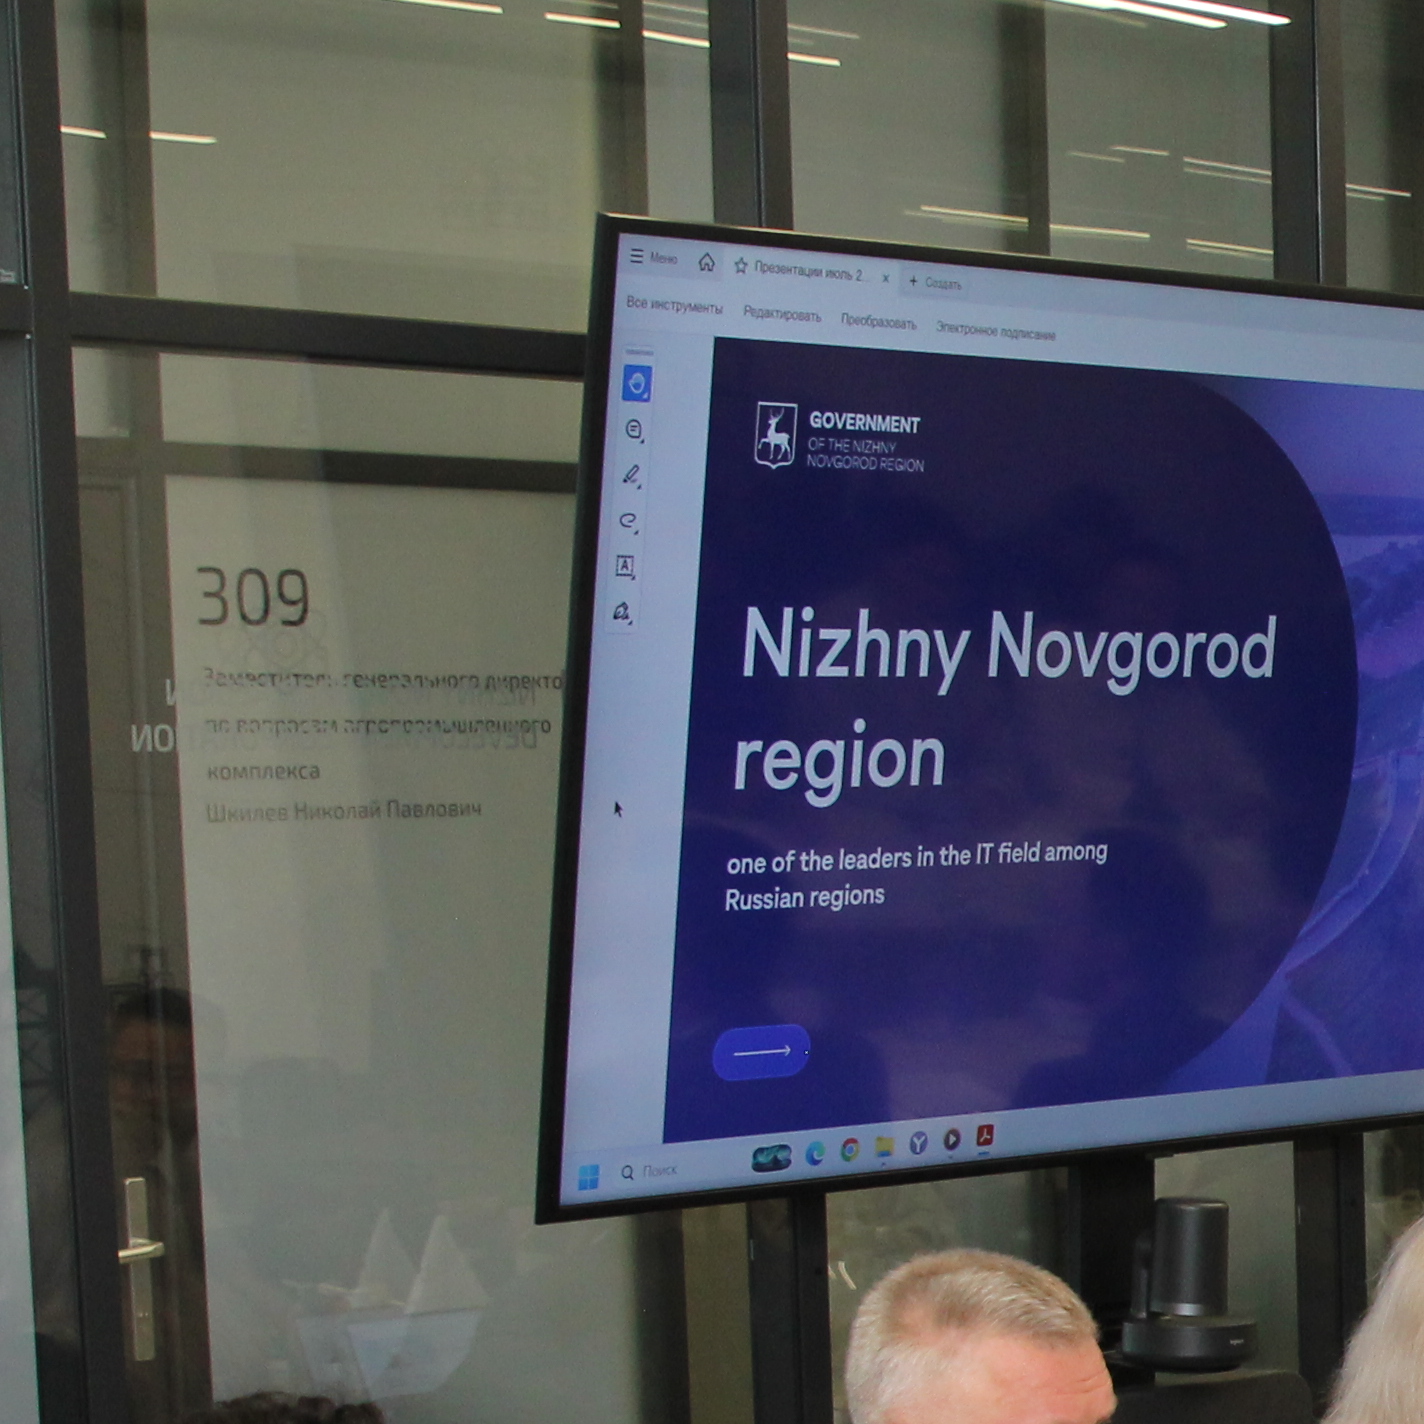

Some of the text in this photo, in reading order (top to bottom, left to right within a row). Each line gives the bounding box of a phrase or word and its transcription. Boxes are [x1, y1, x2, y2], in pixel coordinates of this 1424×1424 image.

[650, 251, 678, 266] Меню
[755, 260, 823, 279] Презентации
[825, 270, 853, 281] июль
[926, 276, 962, 290] Создать
[627, 296, 724, 315] Все инструменты
[743, 305, 822, 323] Редактировать
[841, 312, 917, 330] Преобразовать
[936, 320, 1056, 342] Электронное подписание
[809, 411, 921, 433] GOVERNMENT
[808, 438, 897, 454] OF THE NIZHNY
[806, 454, 925, 472] NOVGOROD REGION
[196, 565, 310, 628] 309
[743, 606, 1277, 696] Nizhny Novgorod
[484, 672, 562, 693] директо
[207, 763, 321, 781] комплекса
[734, 718, 945, 808] region
[206, 799, 482, 823] Шкилев Николай Павлович
[727, 841, 1108, 875] one of the leaders in the IT field among
[725, 883, 885, 911] Russian regions
[642, 1162, 678, 1178] Поиск
